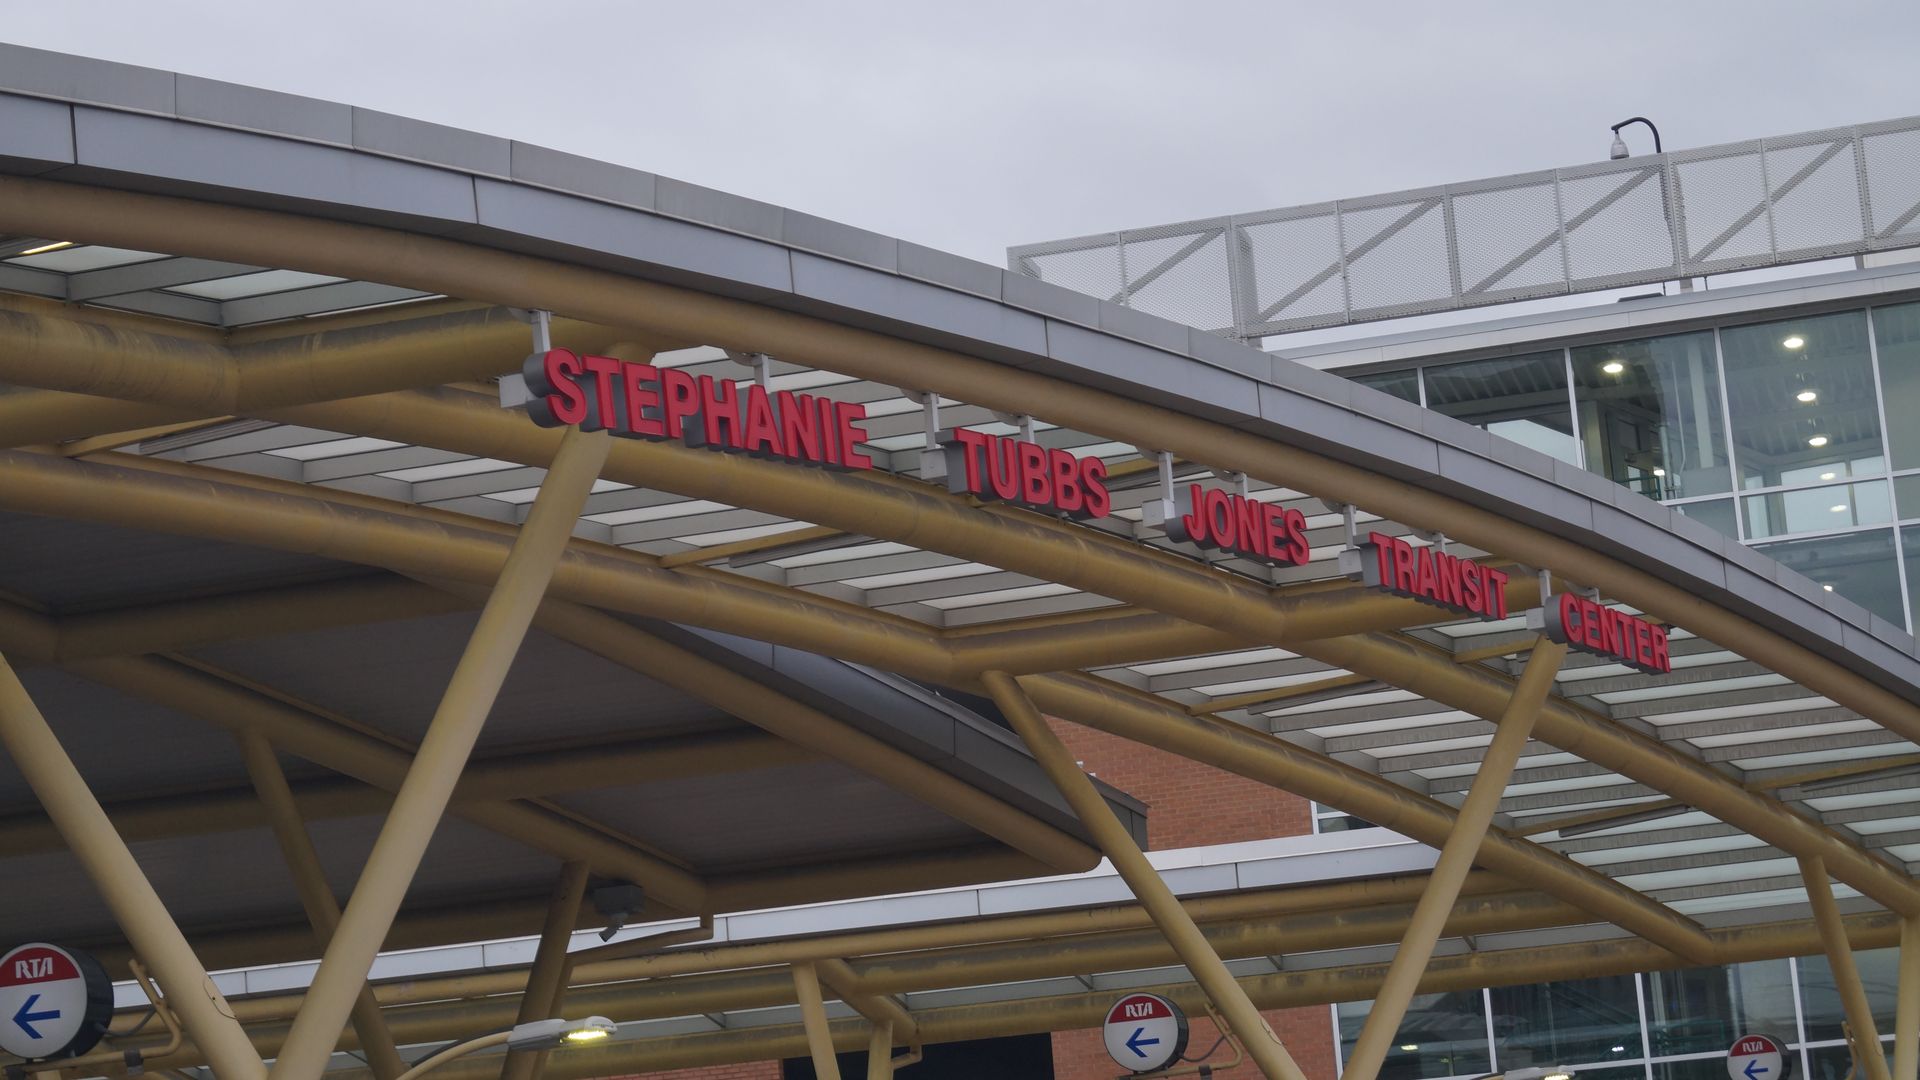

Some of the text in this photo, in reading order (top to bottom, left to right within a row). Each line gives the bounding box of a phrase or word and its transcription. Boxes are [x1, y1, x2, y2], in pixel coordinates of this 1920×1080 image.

[544, 347, 1671, 673] STEPHANIE TUBBS JONES TRANSIT CENTER
[15, 957, 53, 979] RTA
[1125, 1002, 1153, 1018] RTA
[1742, 1041, 1764, 1053] RTA
